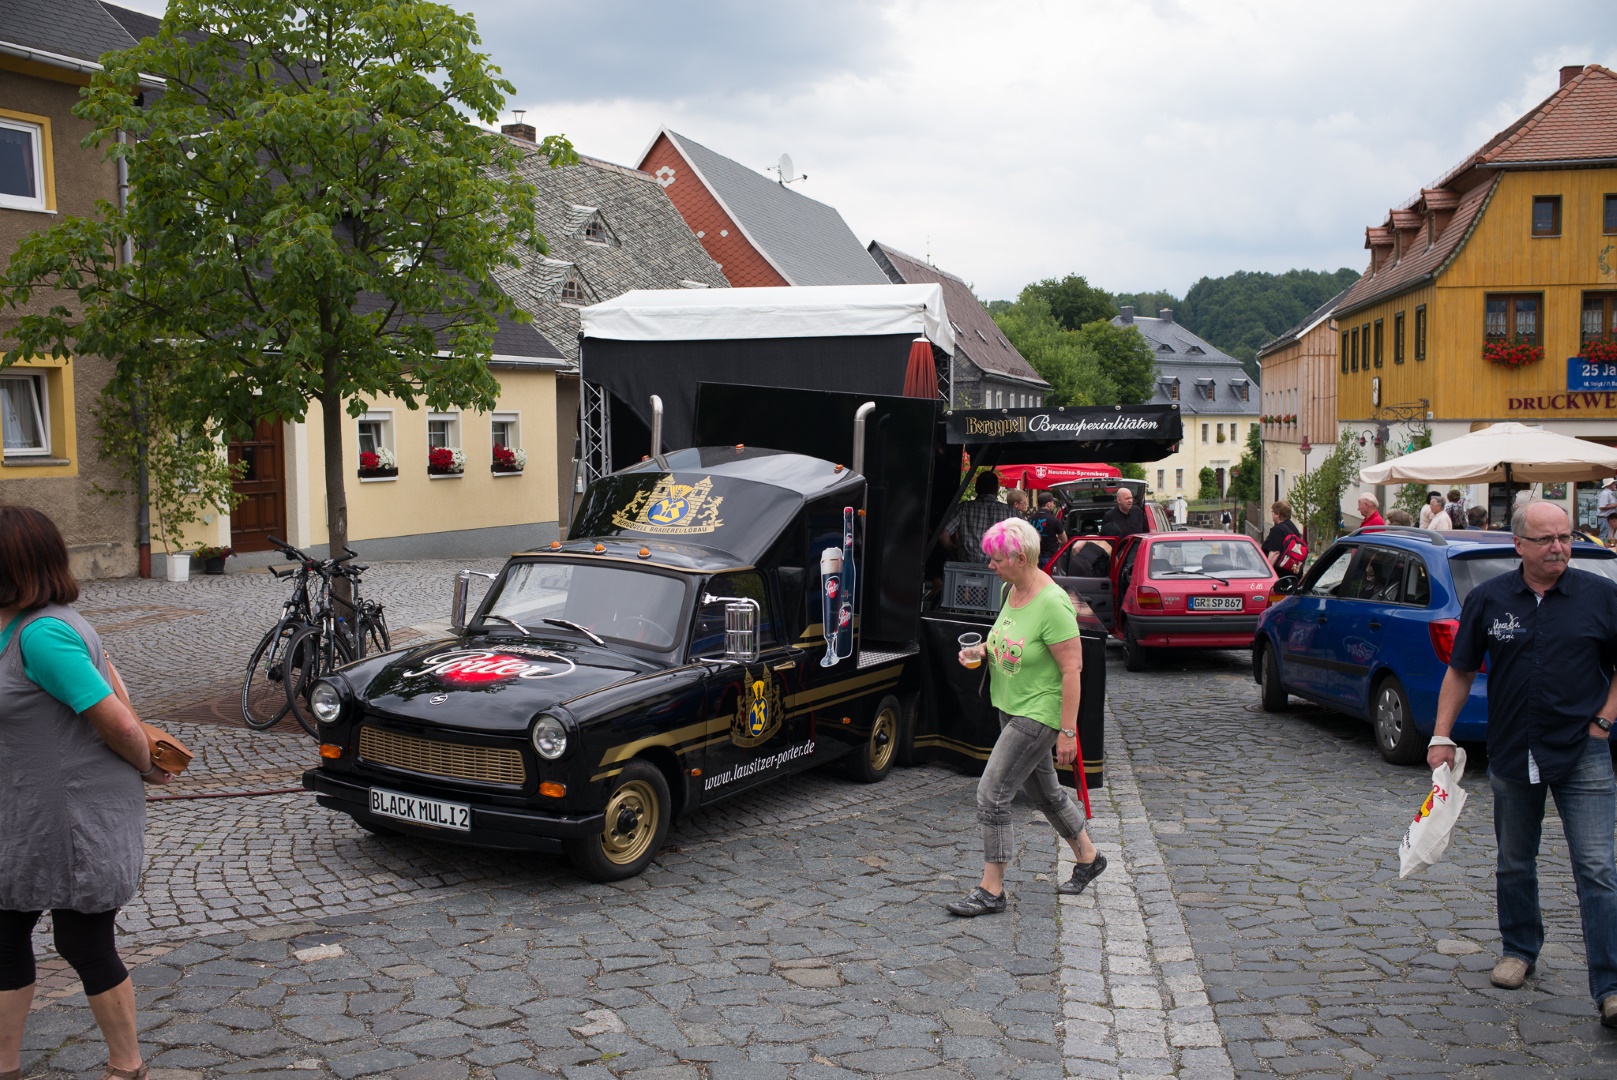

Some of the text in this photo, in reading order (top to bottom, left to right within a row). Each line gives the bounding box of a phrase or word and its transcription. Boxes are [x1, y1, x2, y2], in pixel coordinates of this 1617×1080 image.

[1582, 364, 1617, 376] 25 Ja
[965, 414, 1159, 436] Bergquell Brauspezialitäten
[1047, 469, 1110, 478] Neusalza-Spremberg
[1194, 598, 1241, 608] GR SP 867
[704, 739, 815, 791] www.lausitzer-porter.de
[372, 791, 416, 819] BLACK
[418, 800, 457, 826] MULI
